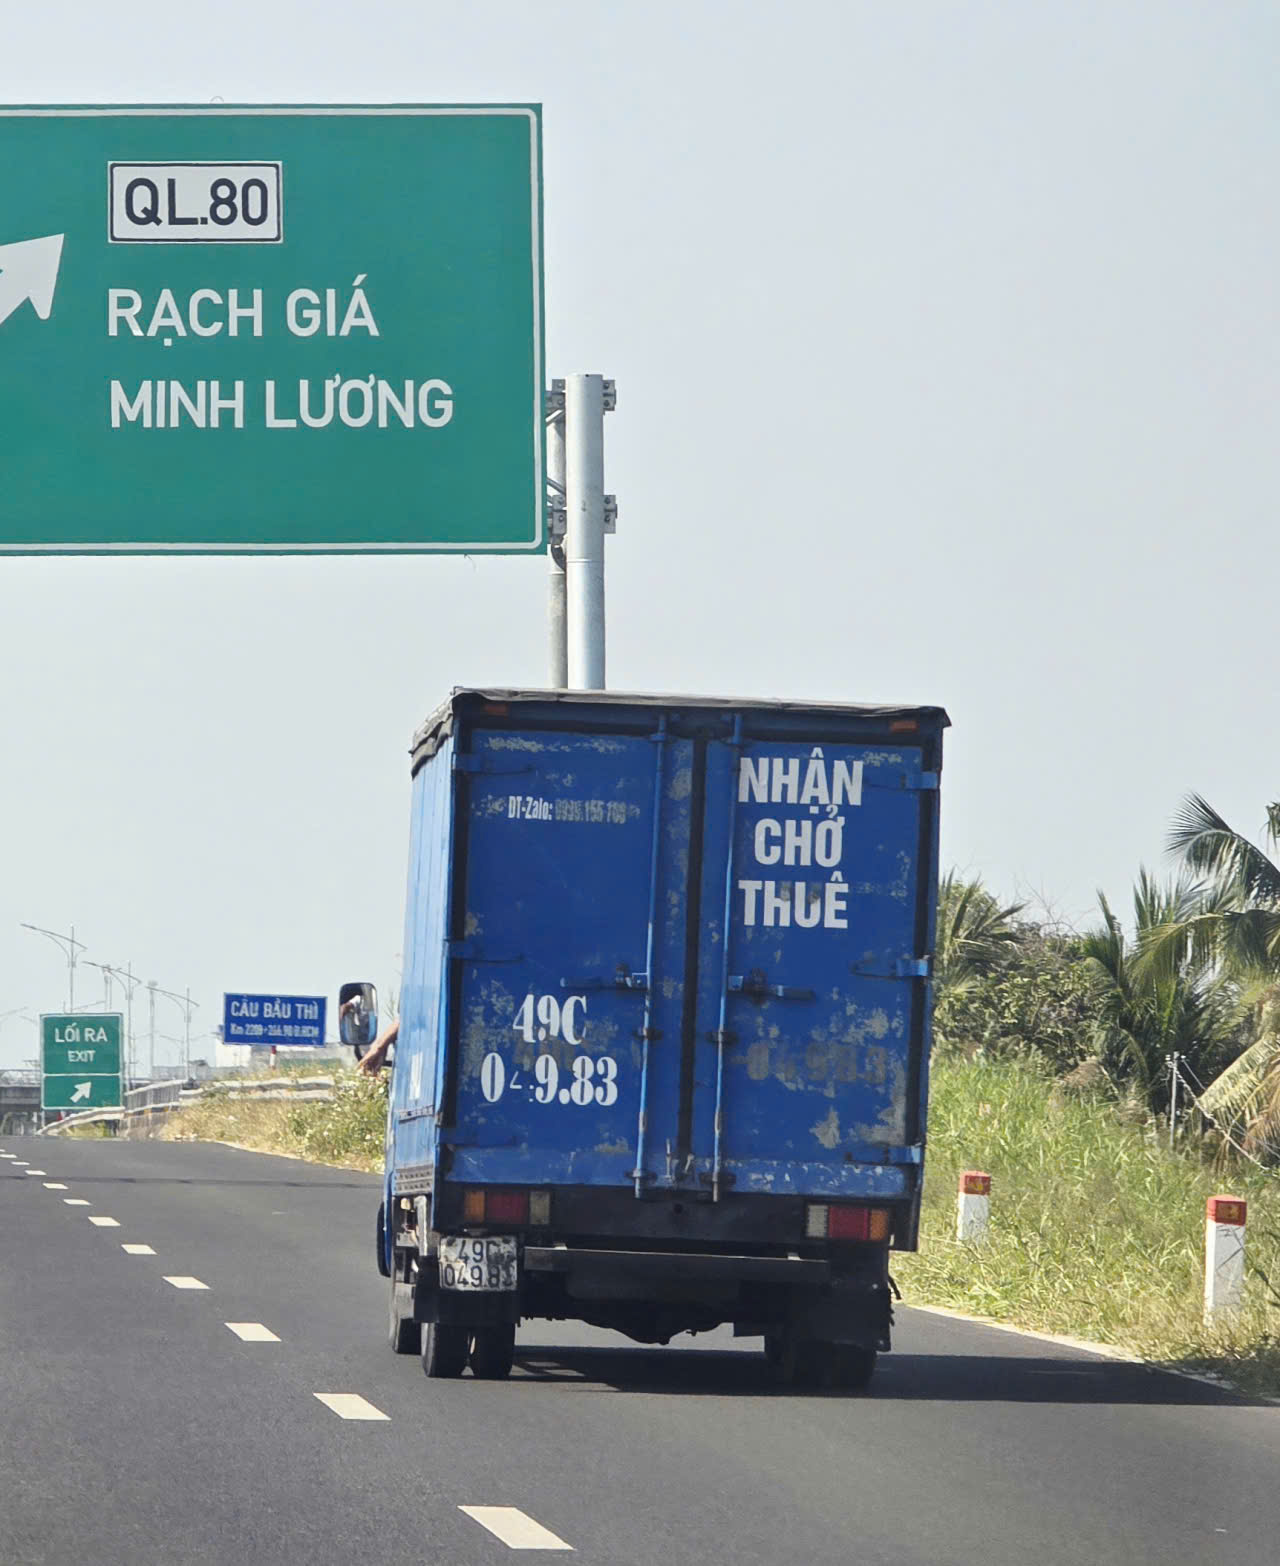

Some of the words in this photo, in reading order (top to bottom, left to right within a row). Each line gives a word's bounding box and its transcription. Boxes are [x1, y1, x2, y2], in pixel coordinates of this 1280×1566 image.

[125, 177, 268, 227] QL.80
[108, 288, 263, 347] RẠCH
[286, 273, 380, 337] GIÁ
[110, 379, 245, 429] MINH
[265, 373, 454, 429] LƯƠNG
[738, 747, 864, 814] NHẬN
[754, 804, 846, 868] CHỞ
[738, 870, 849, 929] THUÊ
[54, 1021, 81, 1043] LỐI
[84, 1027, 108, 1043] RA
[512, 993, 588, 1046] 49C
[67, 1050, 96, 1063] EXIT
